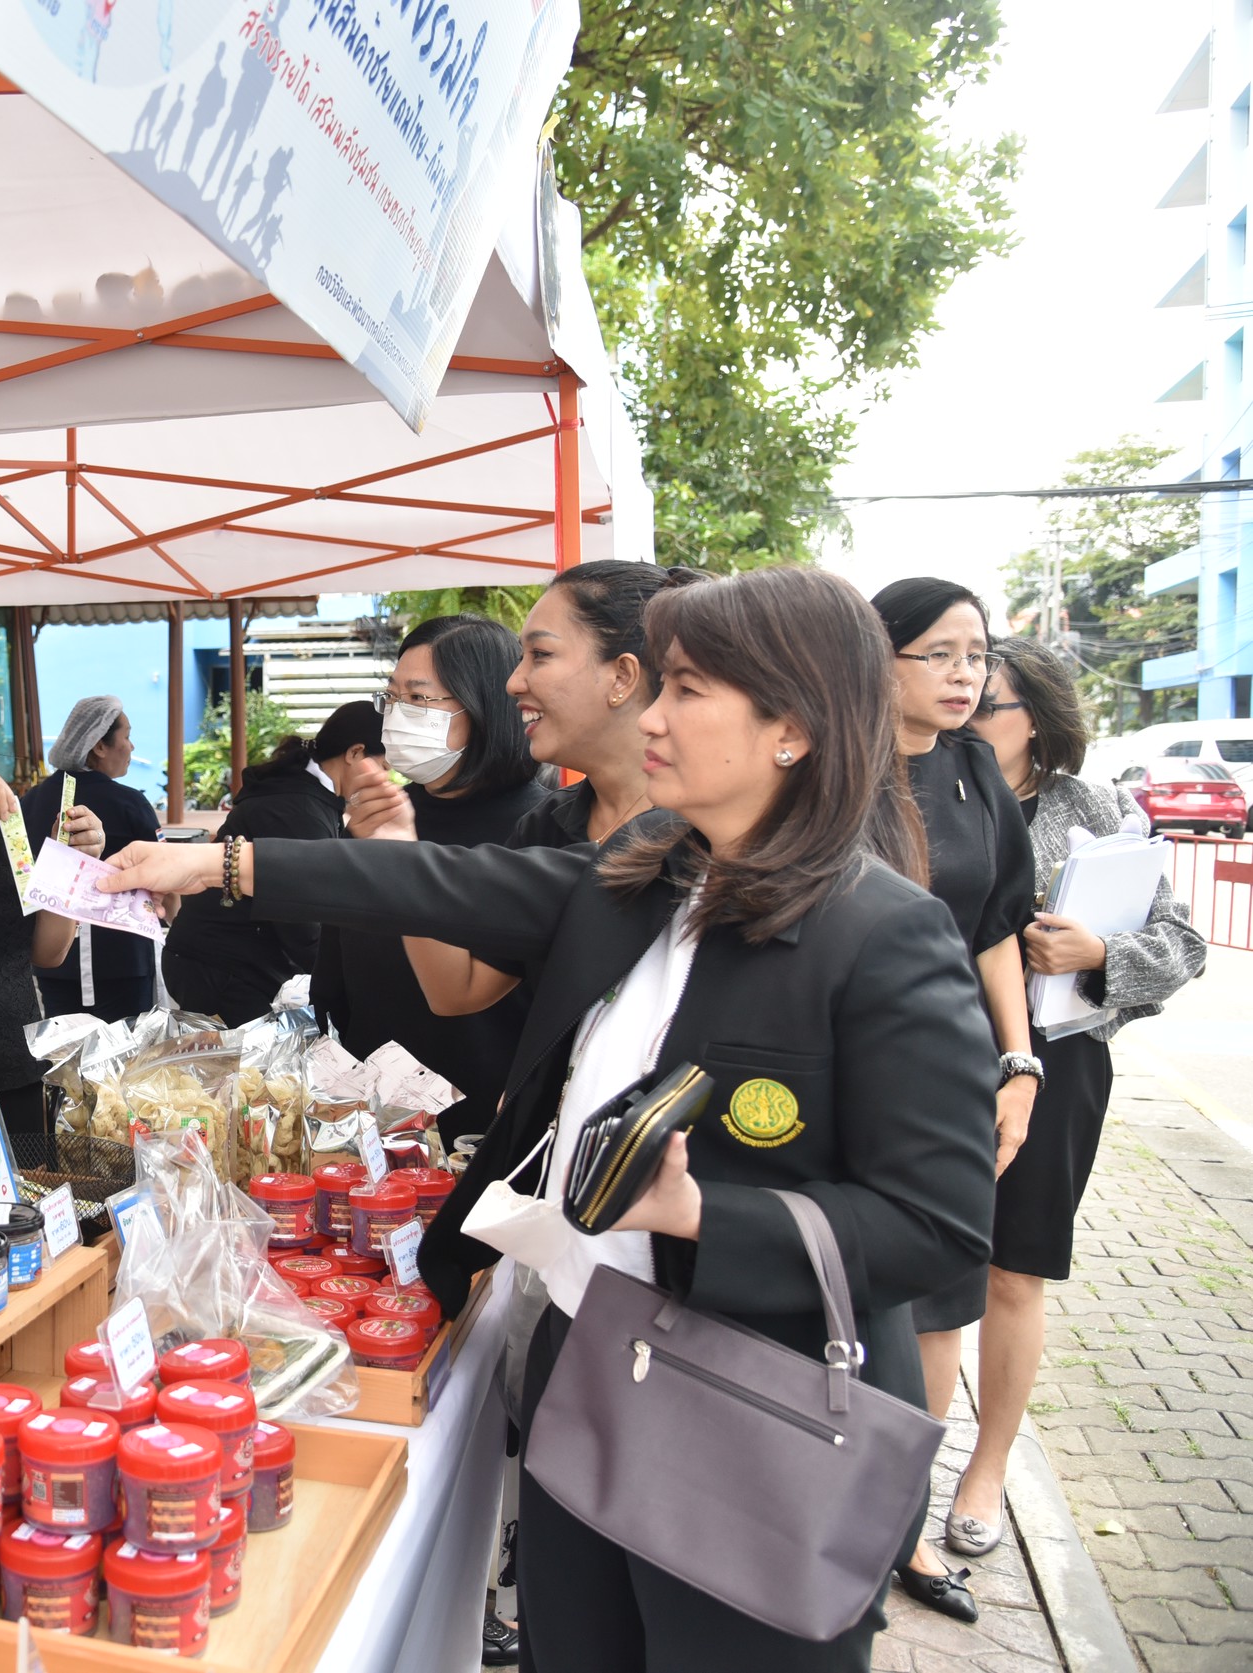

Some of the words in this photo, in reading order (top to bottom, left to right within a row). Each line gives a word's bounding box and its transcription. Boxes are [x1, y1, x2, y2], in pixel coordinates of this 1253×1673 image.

[239, 0, 320, 105] สร้างรายได้
[307, 95, 380, 194] เสริมพลังชุมชน
[28, 887, 57, 908] ๕๐๐
[136, 922, 156, 936] 500
